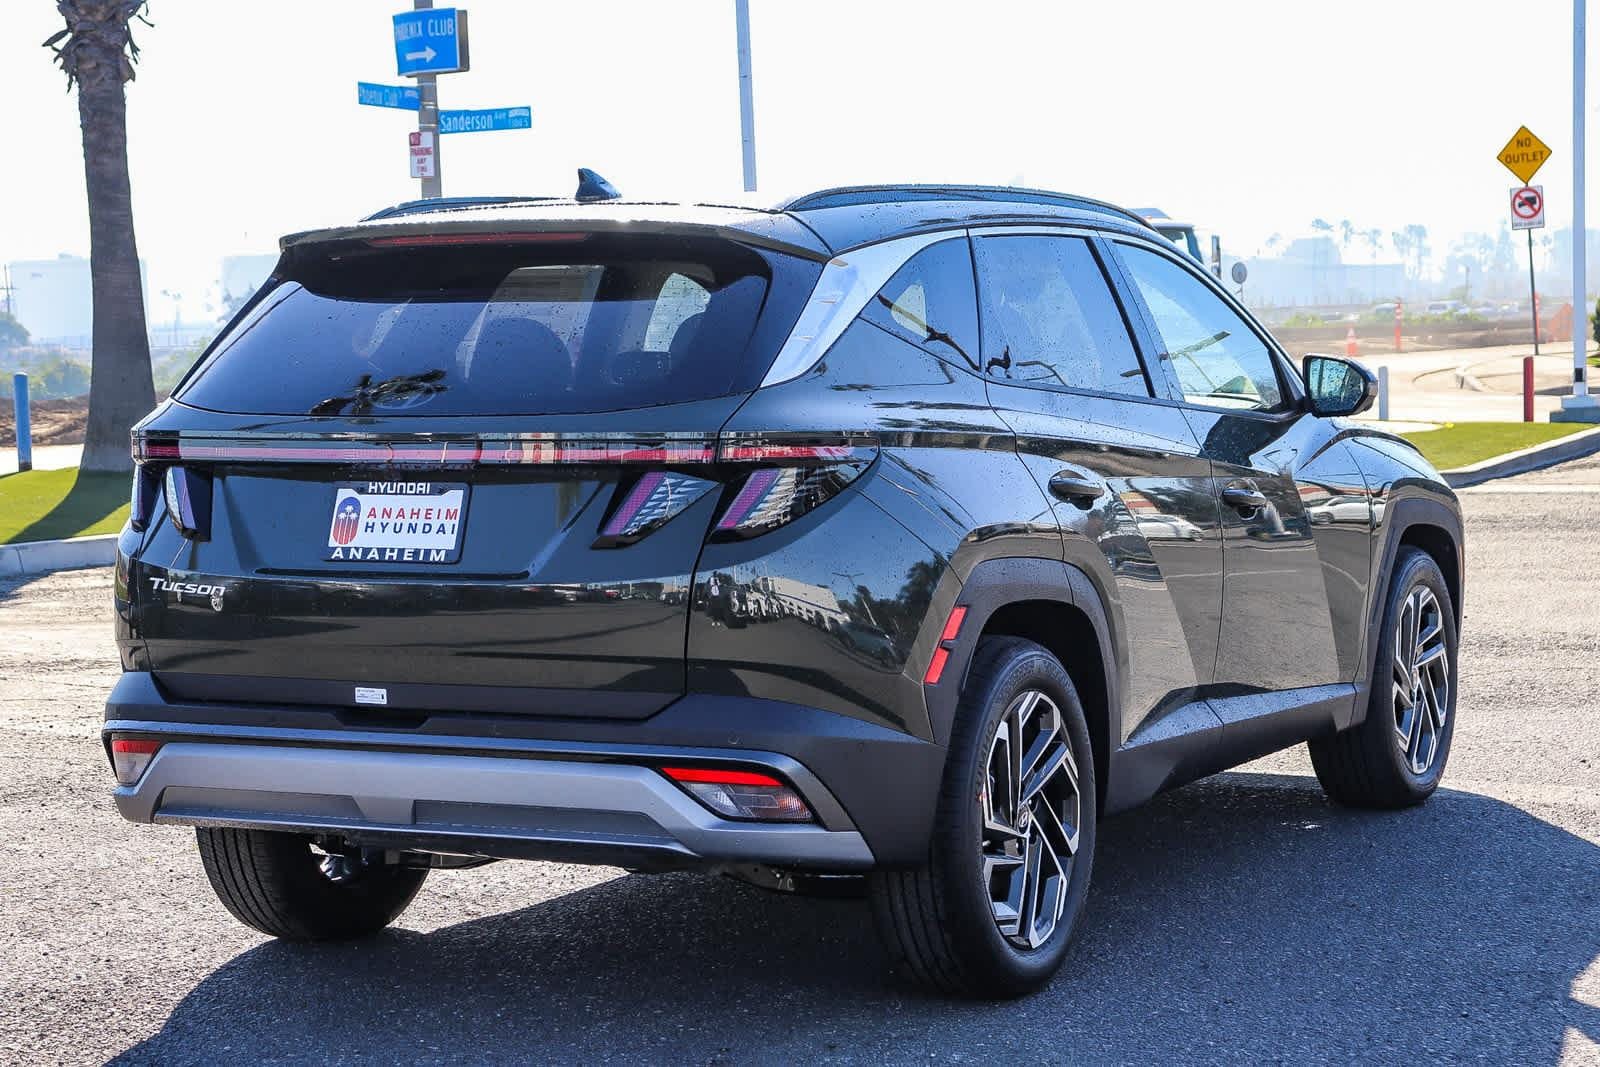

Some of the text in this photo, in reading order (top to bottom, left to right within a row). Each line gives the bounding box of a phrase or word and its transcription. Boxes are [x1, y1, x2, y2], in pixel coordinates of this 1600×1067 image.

[428, 17, 455, 37] CLUB
[440, 113, 494, 132] Sanderson
[1516, 137, 1532, 148] NO
[1504, 150, 1545, 164] OUTLET
[368, 482, 431, 494] HYUNDAI
[367, 507, 459, 521] ANAHEIM
[364, 522, 456, 535] HYUNDAI
[331, 547, 447, 562] ANAHEIM
